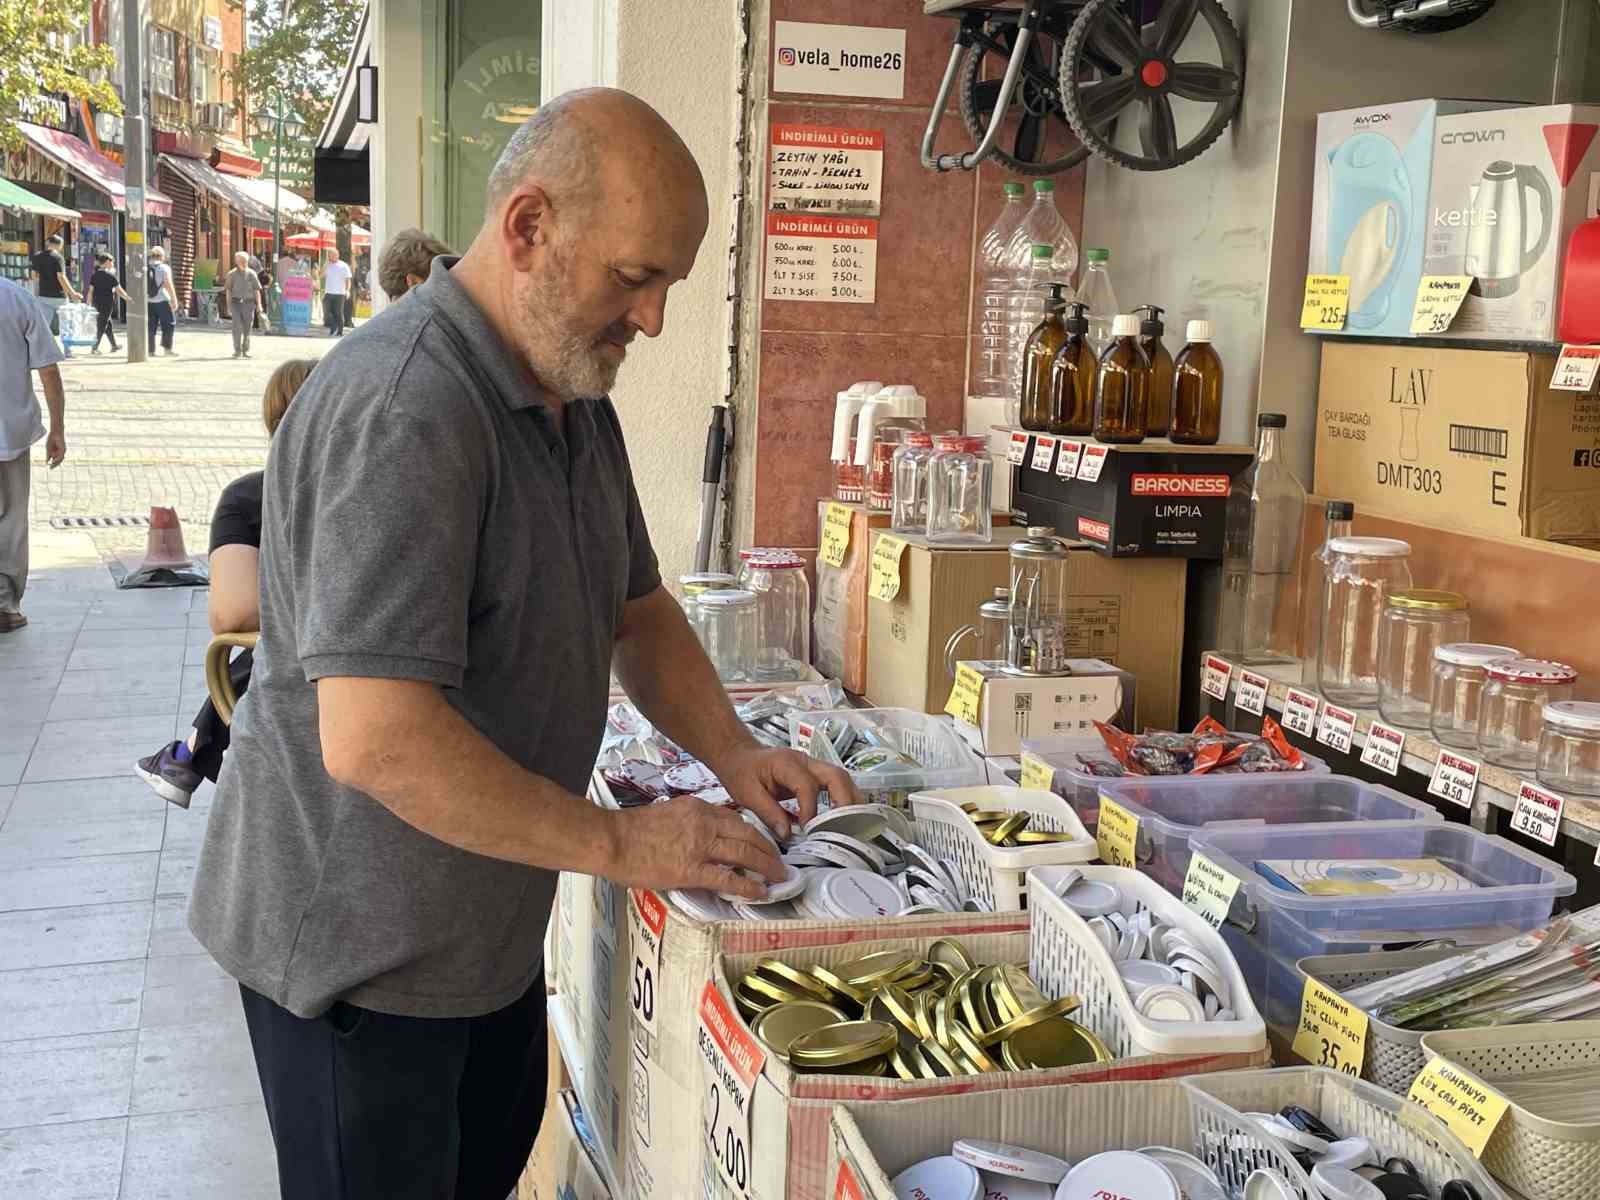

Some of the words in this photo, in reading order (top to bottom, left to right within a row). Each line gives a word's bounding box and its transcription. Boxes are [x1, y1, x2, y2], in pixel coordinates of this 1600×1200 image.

[797, 47, 902, 71] vela_home26
[841, 132, 874, 146] ÜRÜN
[1440, 129, 1505, 145] crown
[1433, 207, 1498, 226] kettle
[837, 223, 868, 235] ÜRÜN
[1389, 366, 1434, 405] LAV
[1328, 425, 1341, 440] TEA
[1341, 428, 1367, 442] GLASS
[1134, 477, 1227, 493] BARONESS
[1377, 461, 1442, 495] DMT303
[1492, 471, 1507, 506] E
[1155, 504, 1202, 518] LIMPIA
